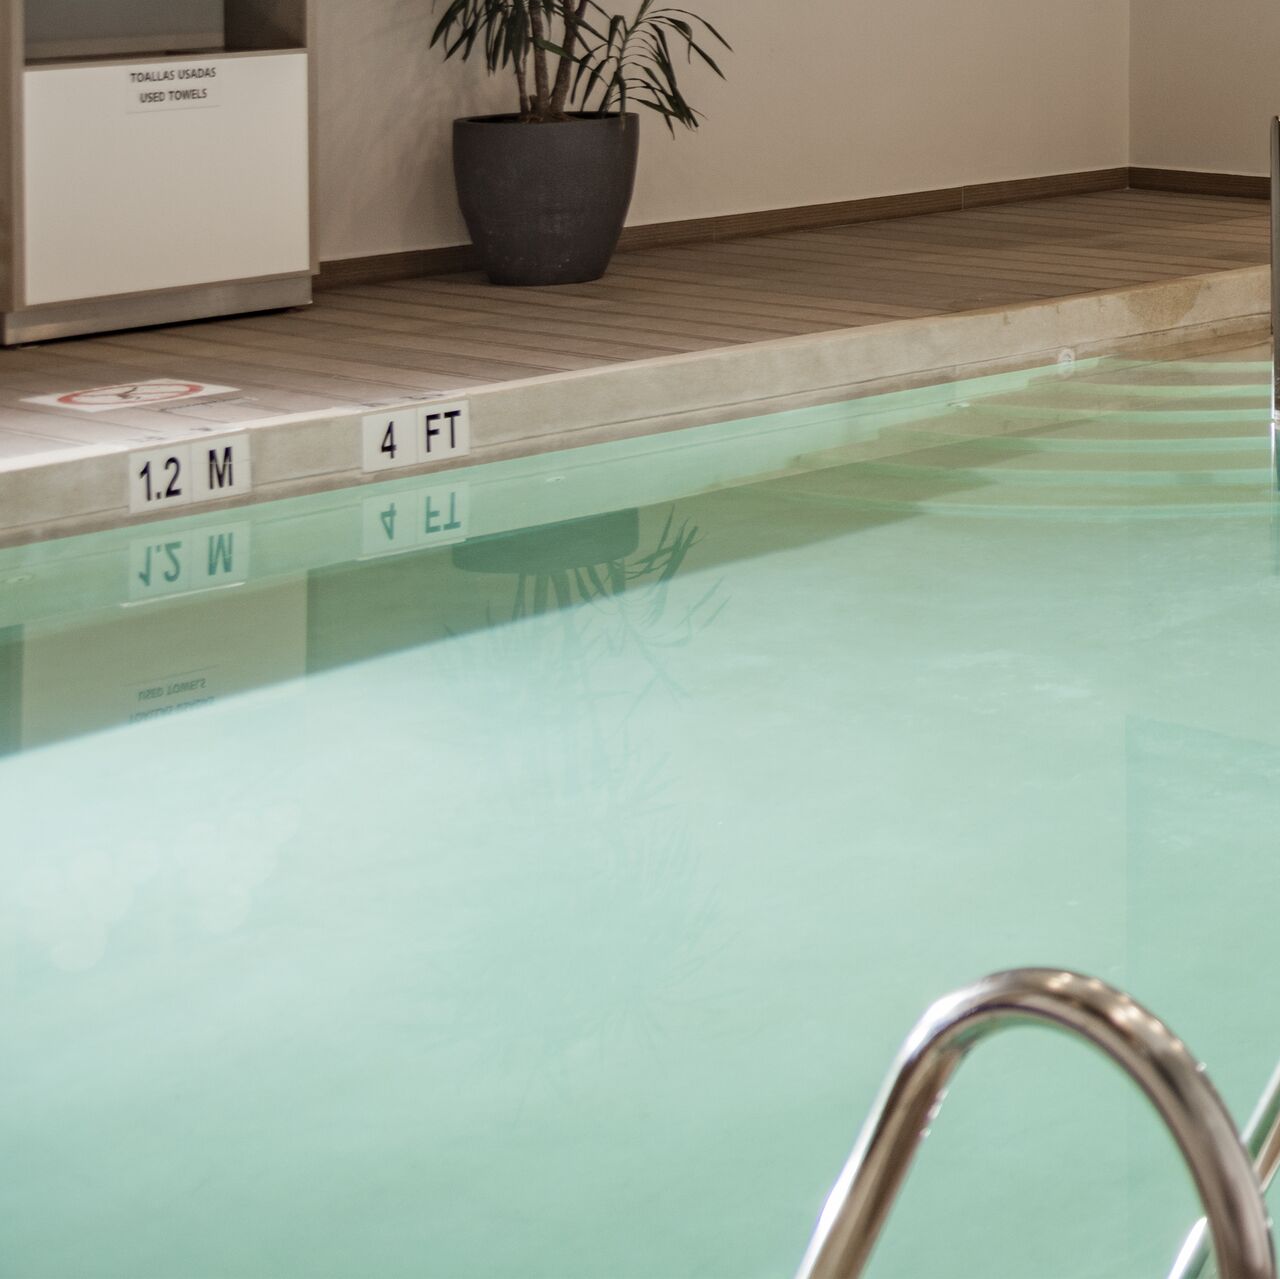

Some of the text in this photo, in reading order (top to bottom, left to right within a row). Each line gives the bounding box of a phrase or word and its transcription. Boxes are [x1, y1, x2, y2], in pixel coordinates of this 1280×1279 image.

[130, 67, 216, 83] TOALLAS USADAS
[140, 88, 207, 103] USED TOWELS
[380, 410, 462, 459] 4 FT
[139, 446, 233, 502] 1.2 M
